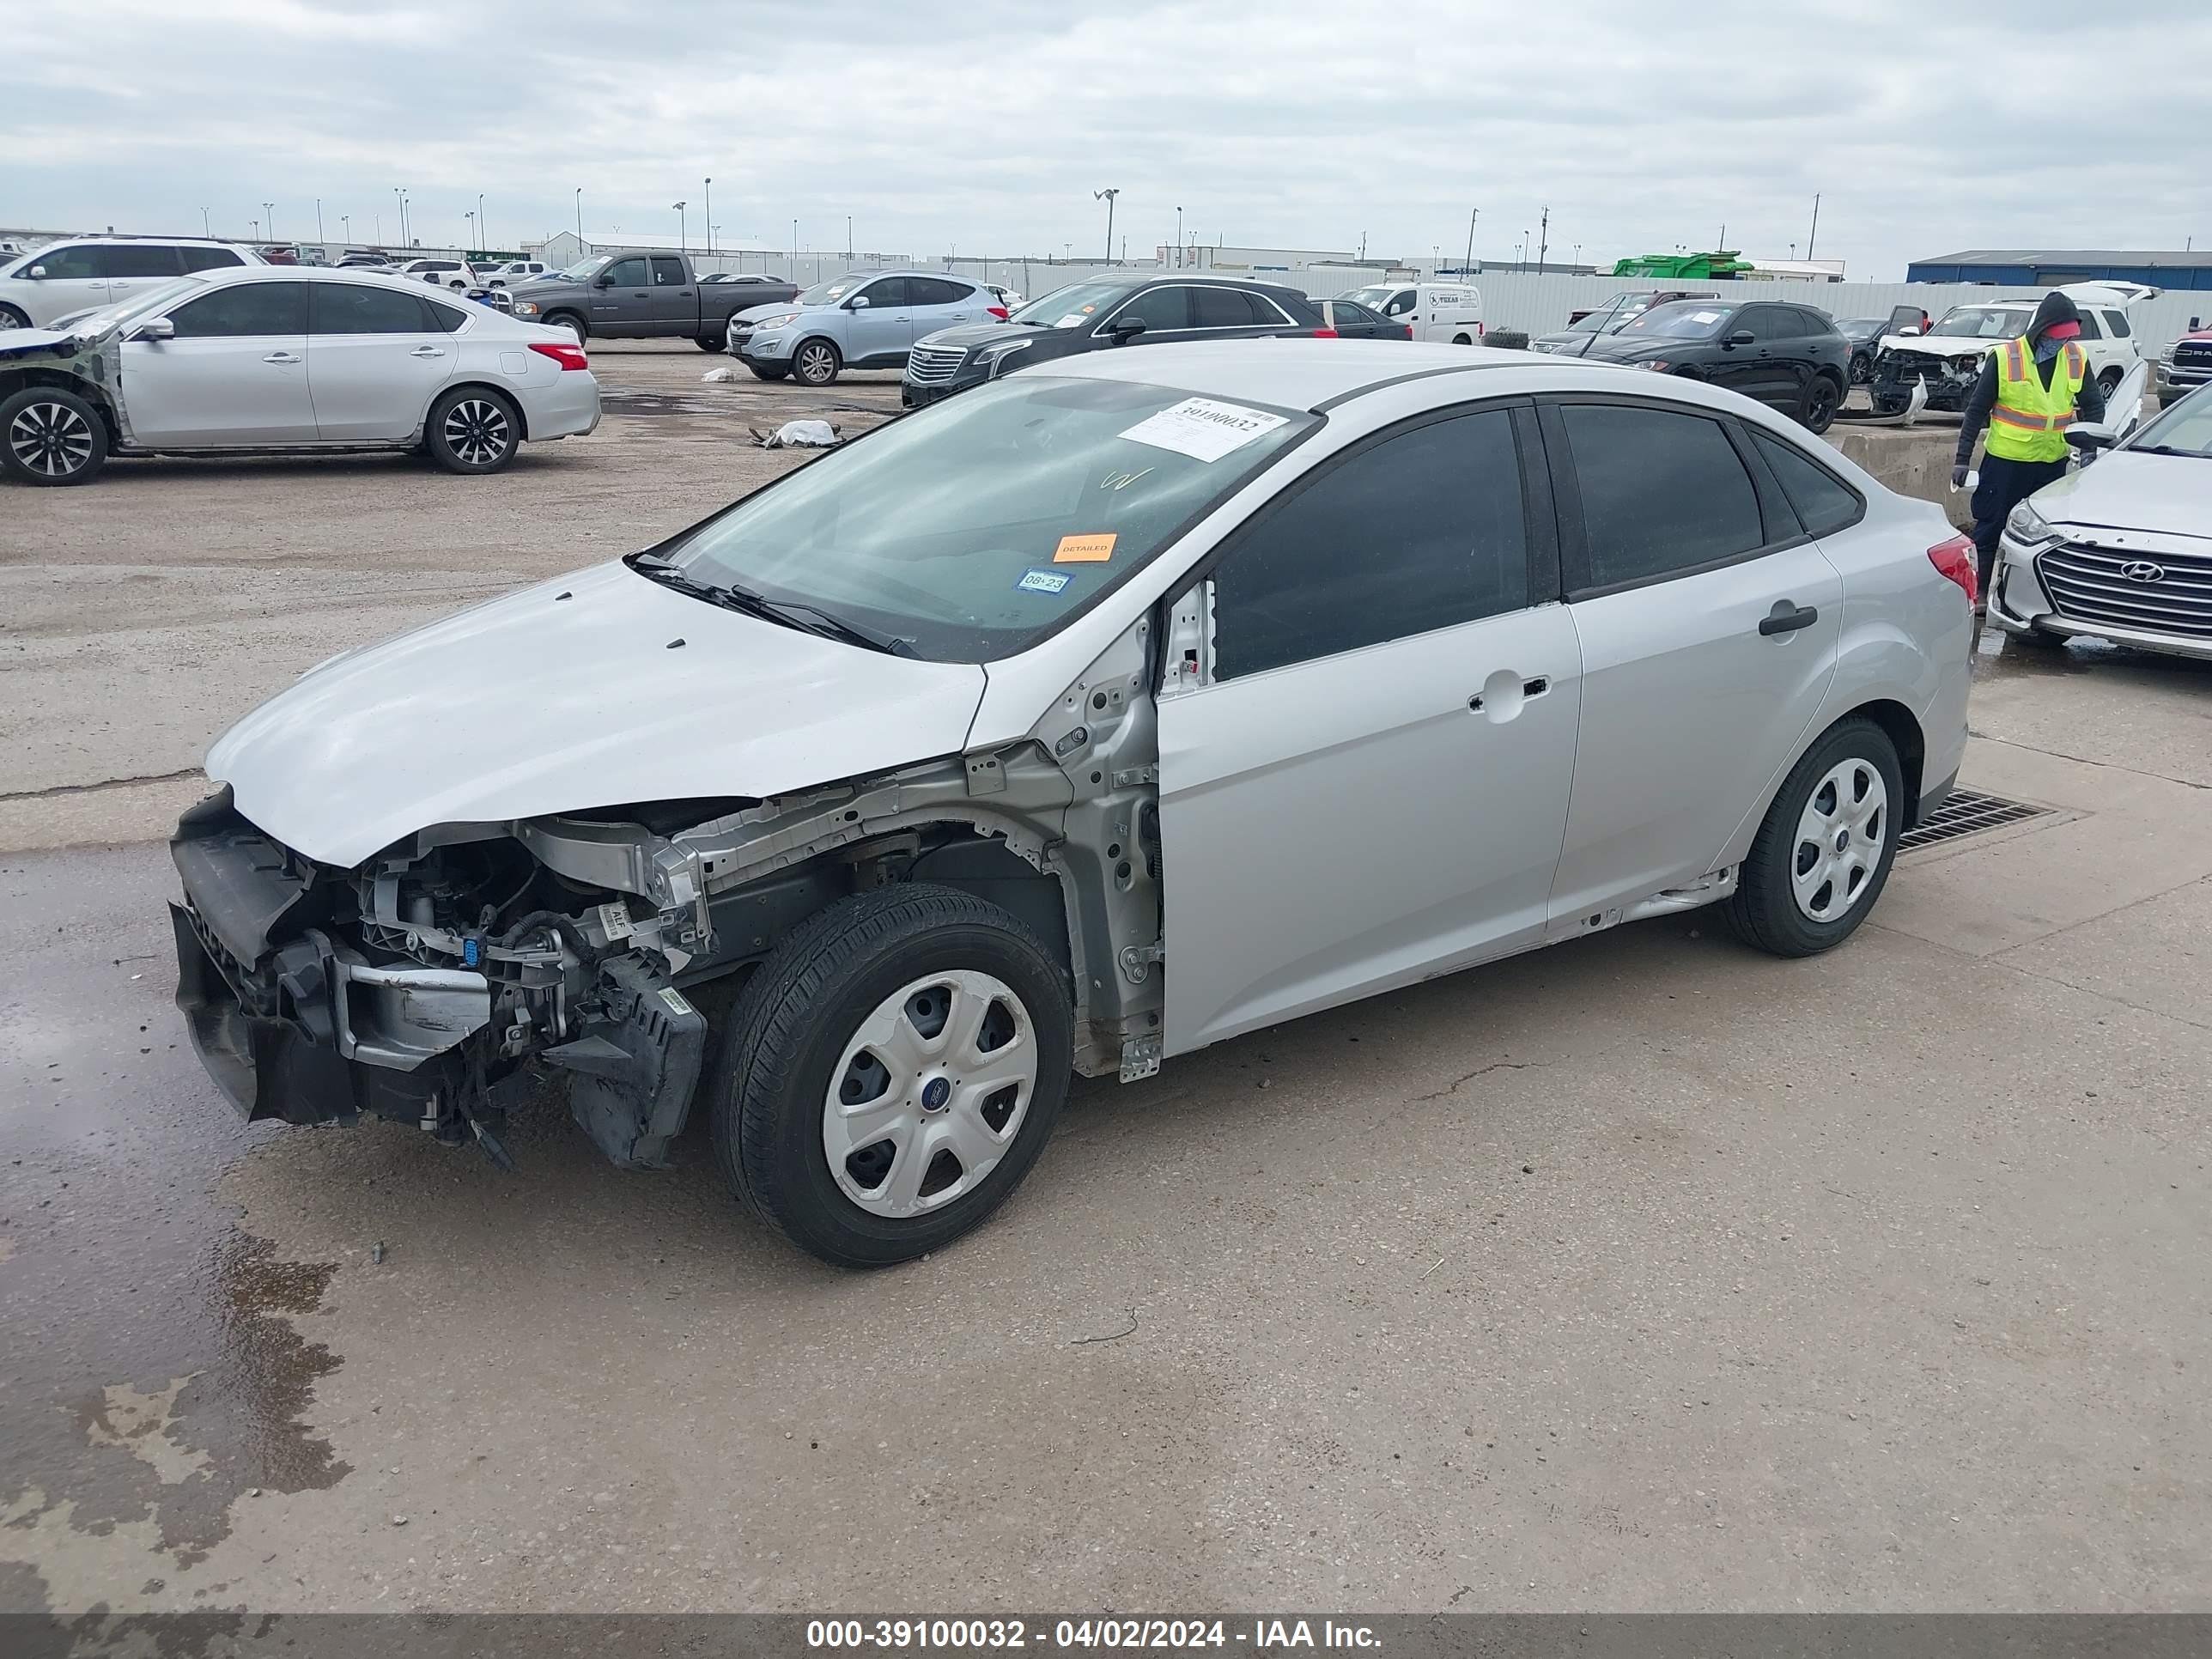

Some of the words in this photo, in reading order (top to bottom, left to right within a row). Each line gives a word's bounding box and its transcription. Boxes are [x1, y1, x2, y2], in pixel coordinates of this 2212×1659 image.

[1175, 406, 1259, 431] 39100032
[1024, 574, 1042, 585] 08
[1045, 578, 1064, 589] 23
[611, 911, 626, 928] ALF
